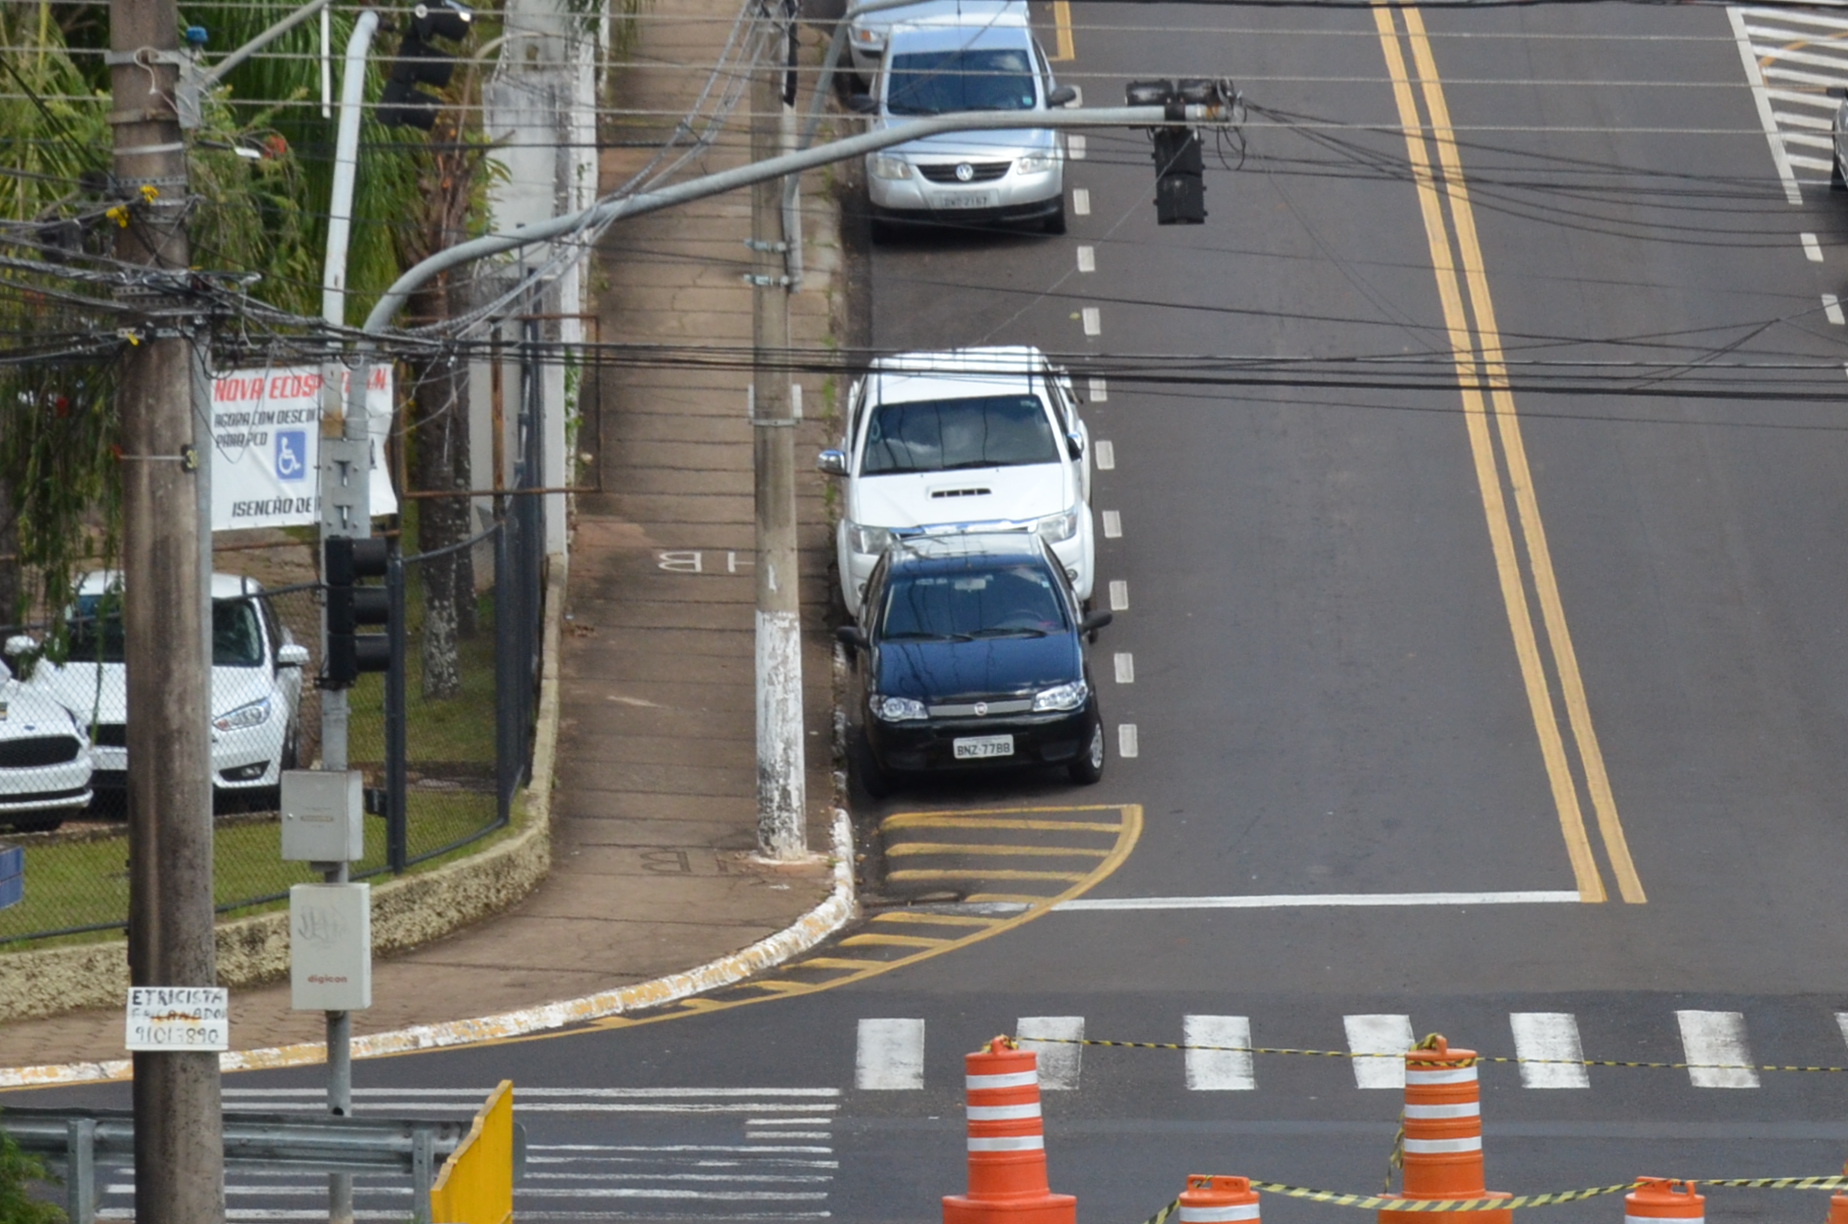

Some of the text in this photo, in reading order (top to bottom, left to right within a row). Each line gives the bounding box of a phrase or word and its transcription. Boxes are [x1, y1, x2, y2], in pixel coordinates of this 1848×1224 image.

[214, 377, 264, 402] NOVA
[213, 412, 251, 428] AGORA
[252, 410, 275, 426] COM
[295, 497, 312, 514] DE
[307, 974, 347, 985] digicon
[132, 989, 222, 1006] ETRICISTA
